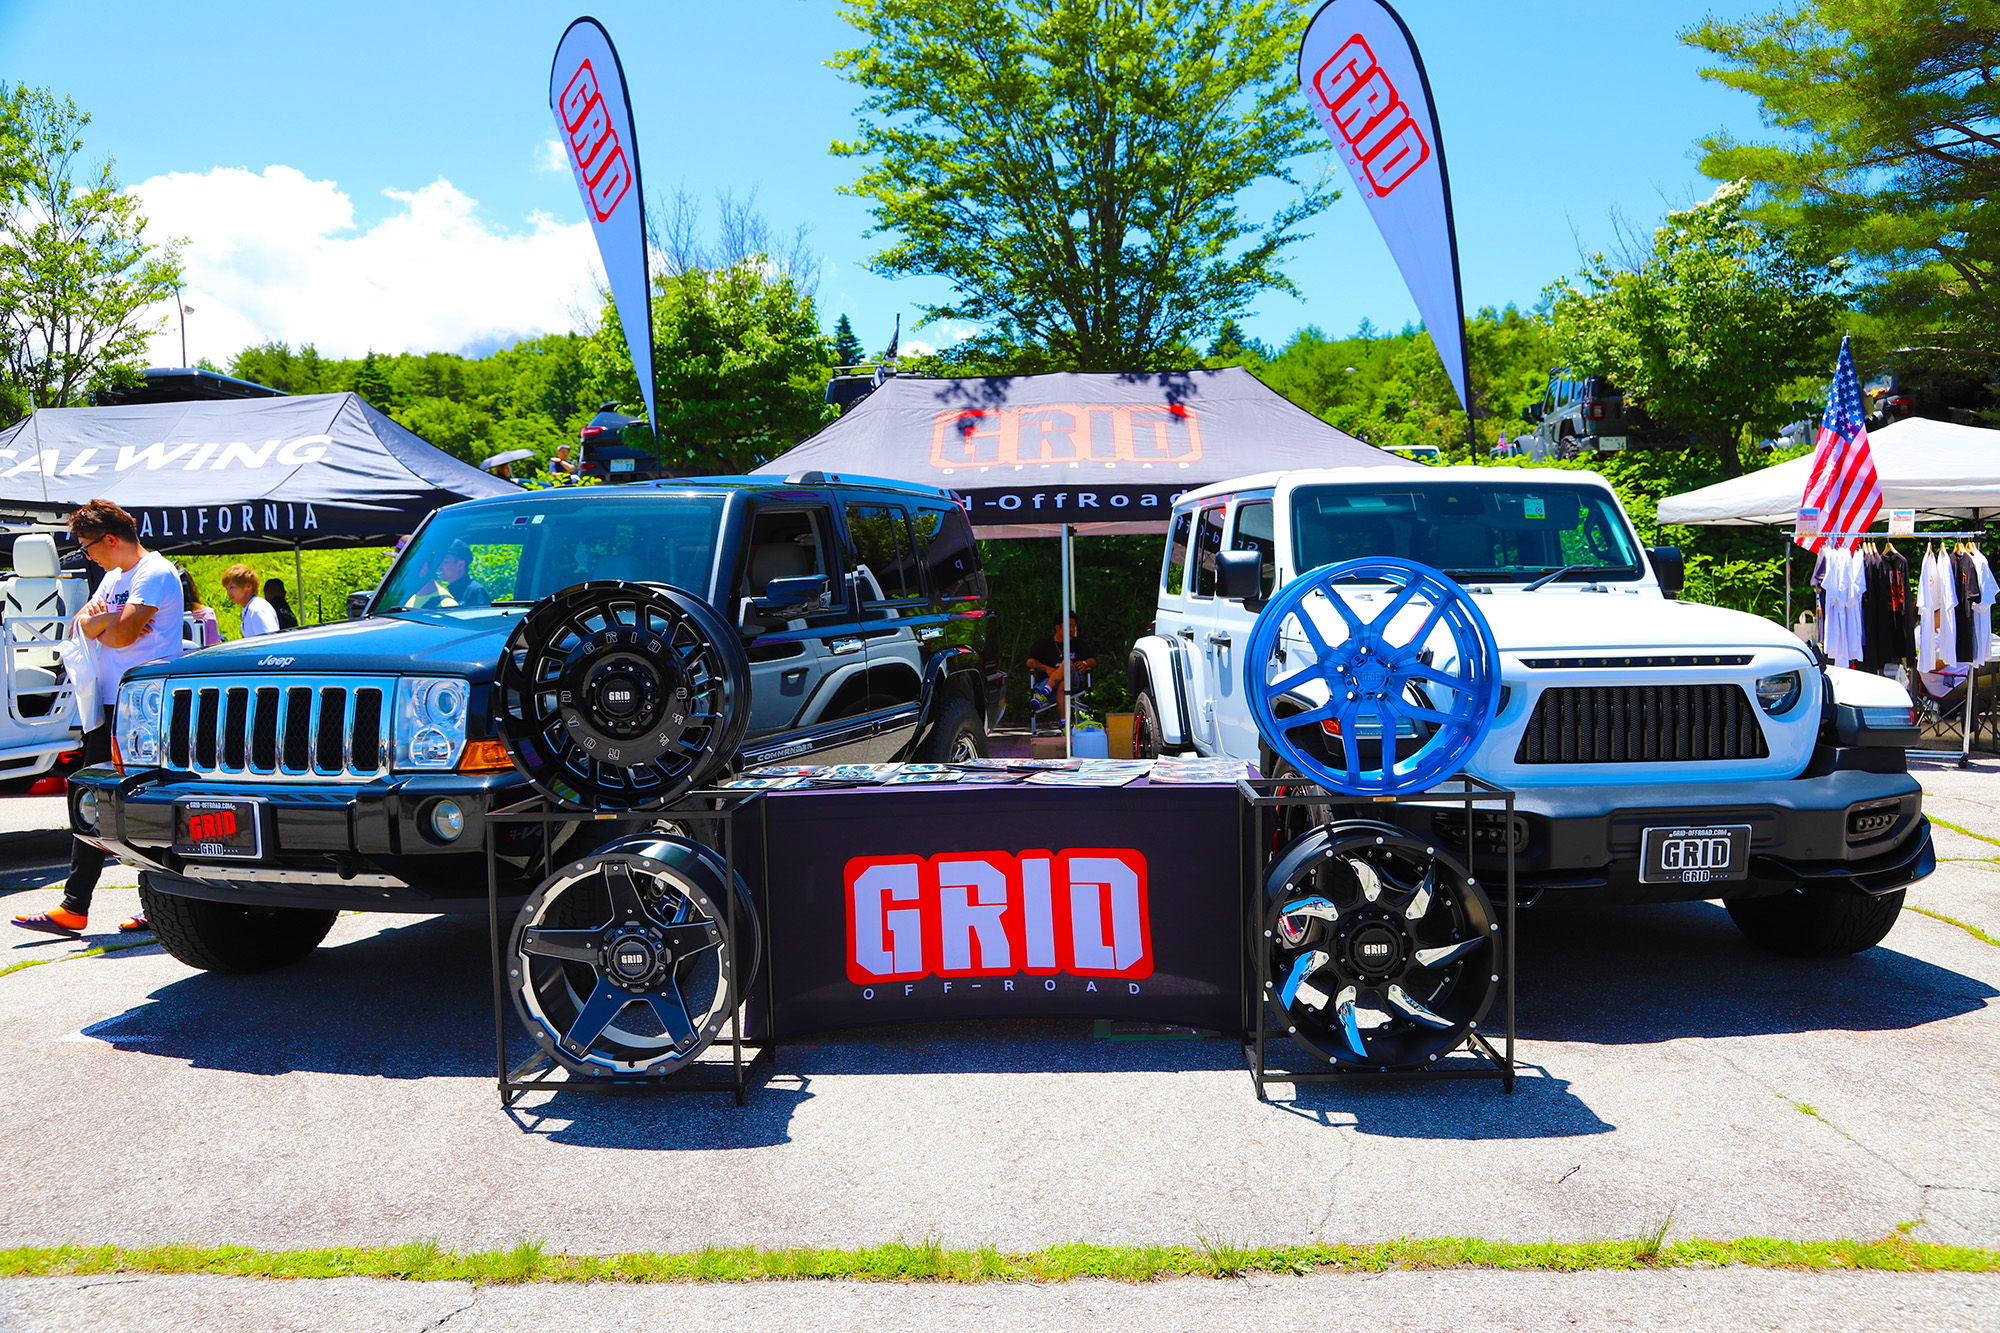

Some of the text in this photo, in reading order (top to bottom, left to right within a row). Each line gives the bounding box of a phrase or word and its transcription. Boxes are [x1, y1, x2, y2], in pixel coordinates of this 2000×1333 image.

[1315, 36, 1428, 195] GRID
[561, 61, 630, 220] GRID
[1308, 87, 1374, 199] OFF-ROAD
[932, 405, 1201, 466] GRID
[942, 462, 1190, 475] OFF-ROAD
[139, 503, 318, 538] ALIFORNIA
[582, 631, 661, 655] GRID
[257, 654, 296, 668] Jeep
[608, 691, 630, 701] GRID
[757, 743, 813, 761] COMMANDER
[189, 810, 237, 840] GRID
[1672, 829, 1727, 837] GRID-OFFROAD.COM
[200, 843, 224, 856] GRID
[1663, 839, 1730, 869] GRID
[1682, 870, 1710, 882] GRID
[850, 854, 1148, 979] GRID
[621, 954, 643, 964] GRID
[1364, 944, 1388, 955] GRID
[862, 979, 1141, 1001] OFF-ROAD
